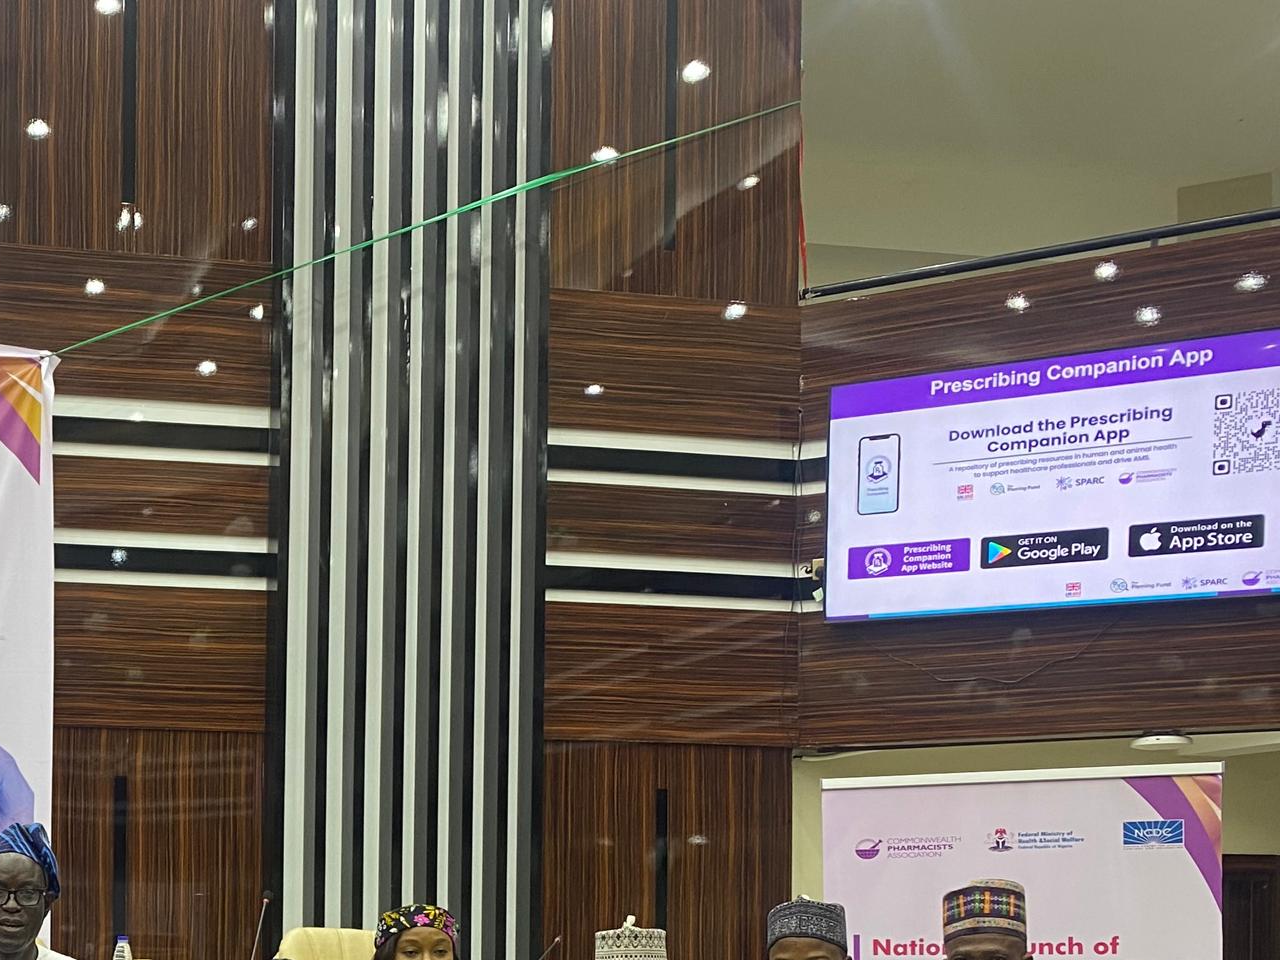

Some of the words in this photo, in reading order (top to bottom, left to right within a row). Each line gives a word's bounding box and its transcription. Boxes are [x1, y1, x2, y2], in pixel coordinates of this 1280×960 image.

[930, 369, 1041, 396] Prescribing
[1047, 356, 1163, 381] Companion
[1169, 348, 1213, 366] App
[949, 420, 1033, 442] Download
[1038, 417, 1066, 432] the
[1071, 406, 1173, 429] Prescribing
[987, 430, 1089, 453] Companion
[1094, 427, 1130, 443] App
[955, 464, 988, 472] repository
[999, 458, 1037, 468] prescribing
[1039, 455, 1073, 464] resources
[1127, 446, 1152, 454] animal
[1153, 444, 1177, 452] health
[983, 469, 1009, 477] support
[1010, 466, 1048, 474] healthcare
[1050, 461, 1096, 471] professionals
[1075, 476, 1105, 486] SPARC
[1171, 522, 1218, 534] Download
[1221, 522, 1233, 530] on
[1236, 520, 1252, 528] the
[1018, 538, 1034, 546] GET
[1036, 537, 1043, 545] IT
[1044, 536, 1058, 544] ON
[1170, 535, 1205, 551] App
[1207, 532, 1253, 546] Store
[904, 544, 951, 554] Prescribing
[1018, 544, 1069, 561] Google
[1072, 543, 1101, 557] Play
[903, 552, 951, 563] Companion
[901, 563, 918, 573] App
[919, 561, 953, 570] Website
[1200, 578, 1228, 587] SPARC
[1134, 828, 1173, 837] NCDC
[887, 836, 962, 845] COMMONWEALTH
[888, 844, 953, 852] PHARMACISTS
[873, 938, 946, 956] Natio
[1027, 936, 1083, 955] unch
[1094, 936, 1120, 955] of
